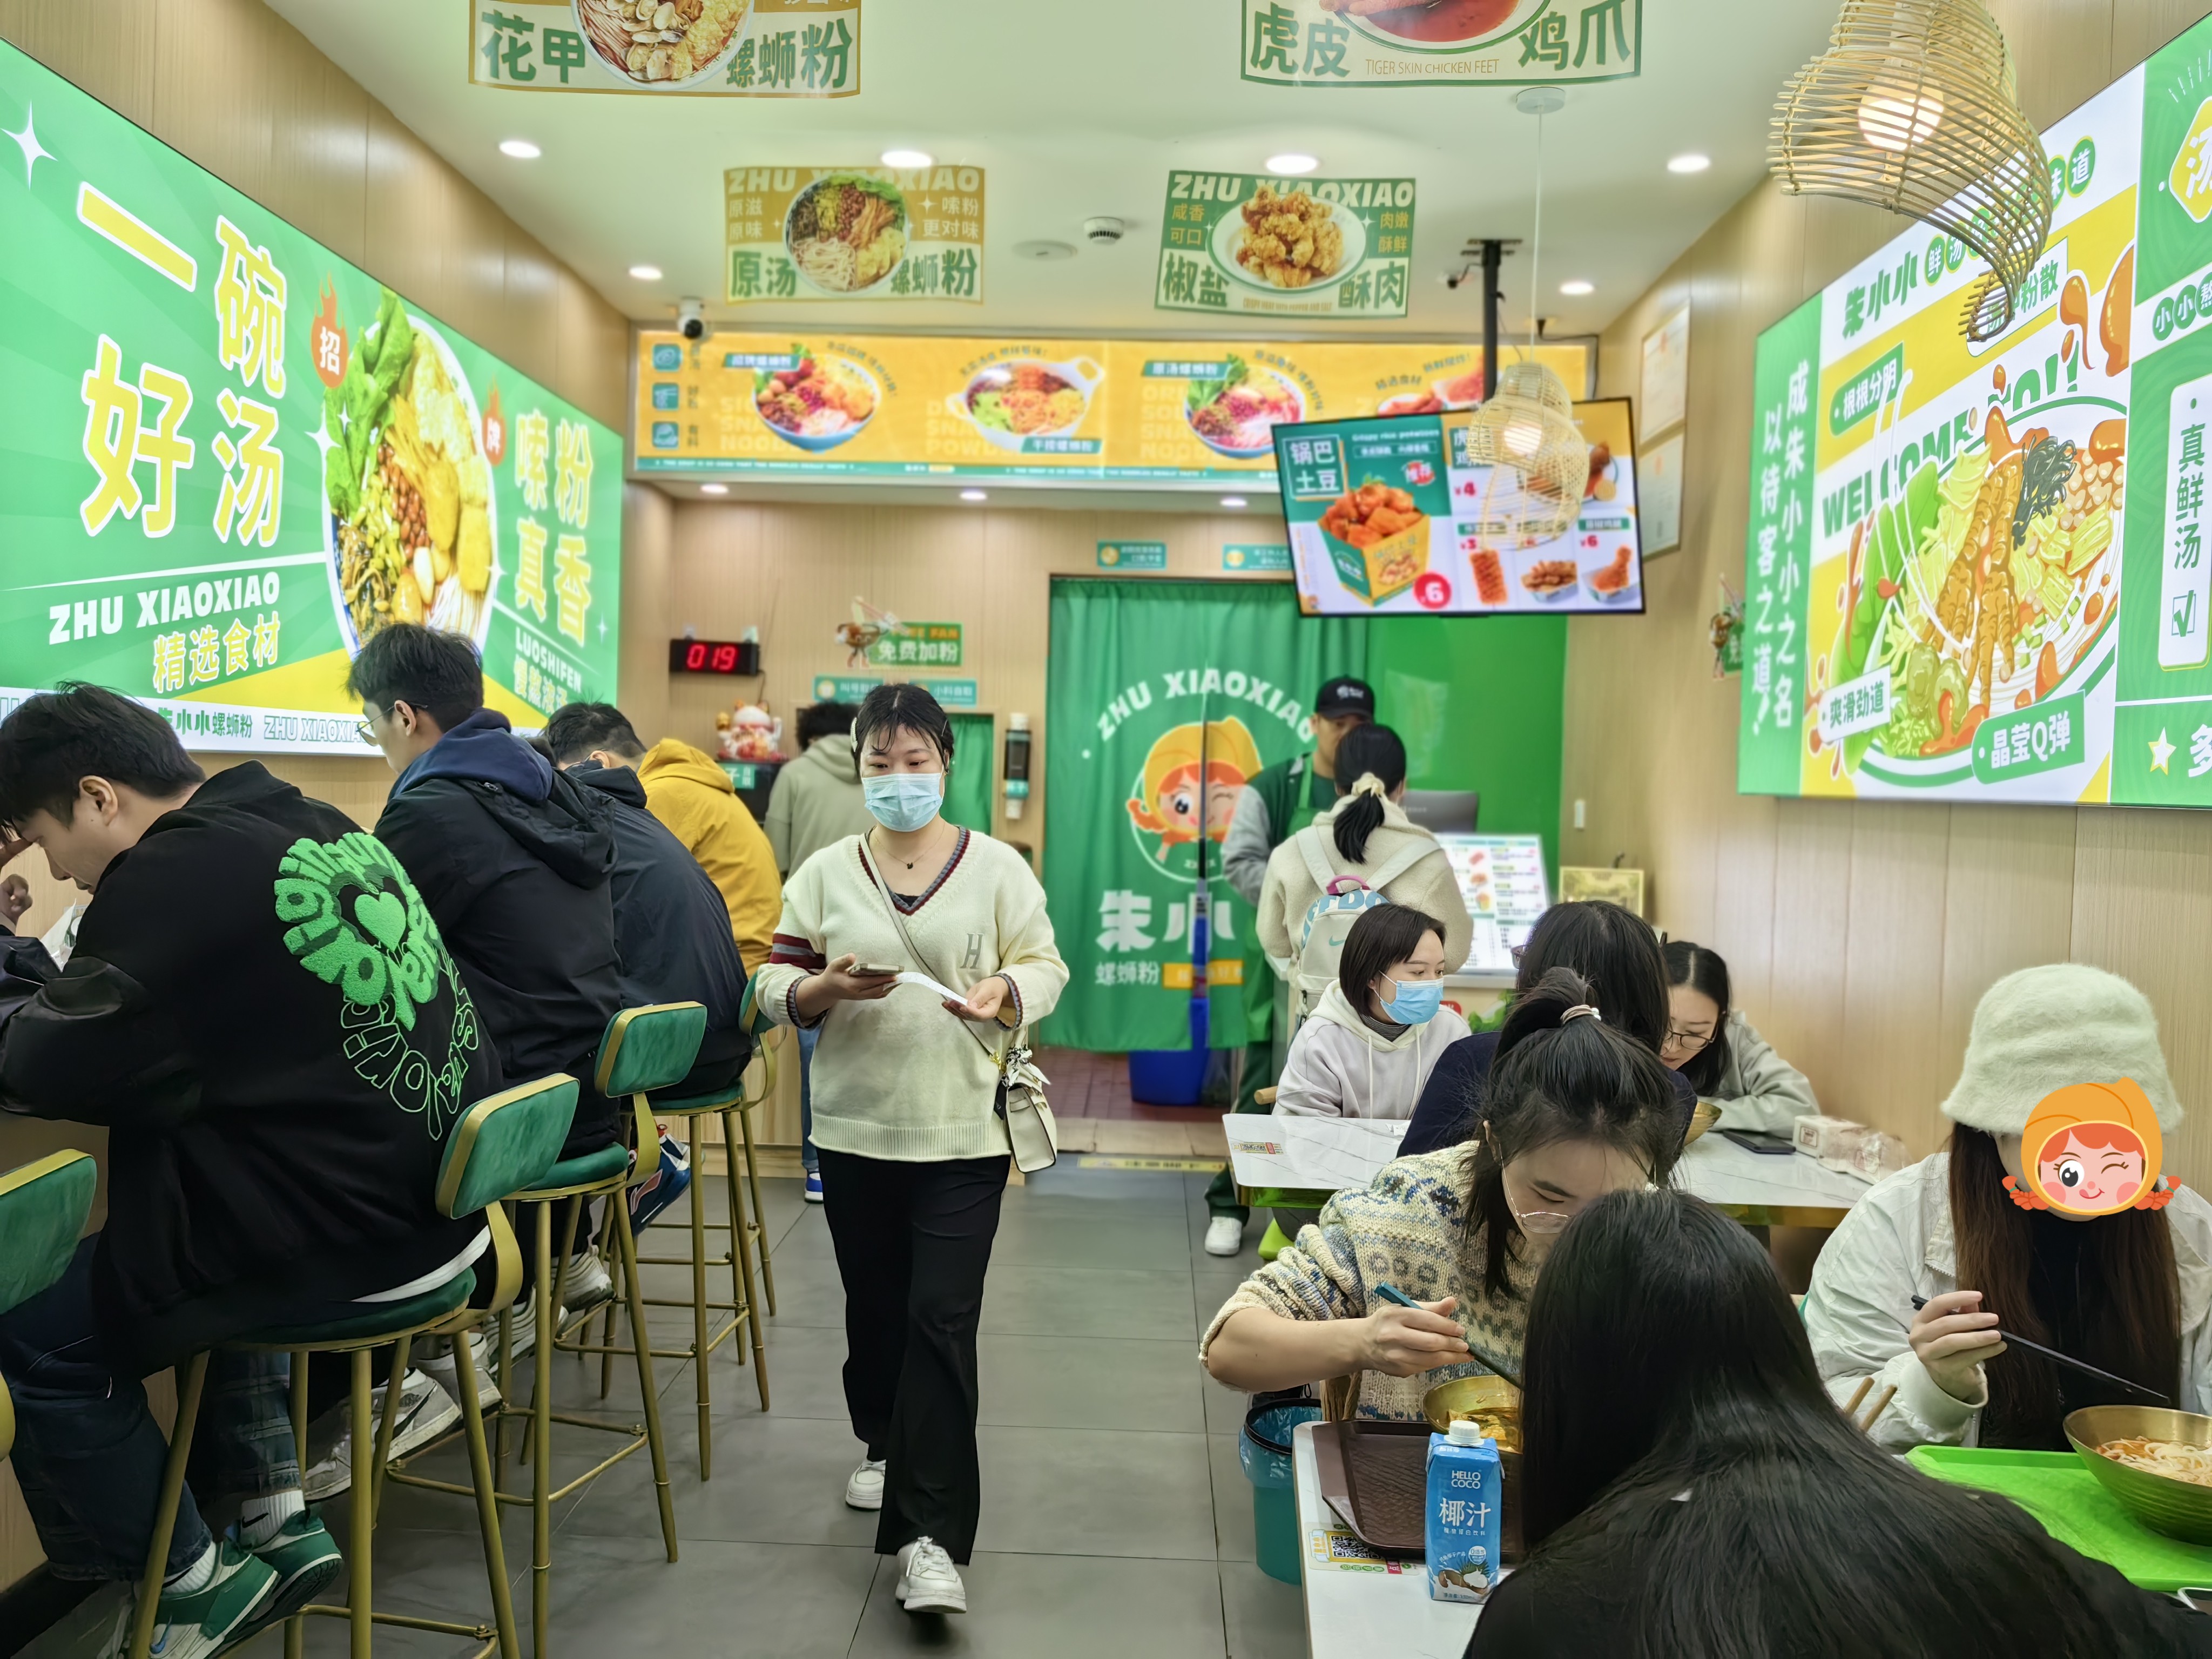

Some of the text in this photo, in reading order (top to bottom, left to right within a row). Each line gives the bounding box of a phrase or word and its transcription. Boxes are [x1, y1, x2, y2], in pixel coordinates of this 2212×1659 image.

[481, 10, 853, 89] 花甲 螺蛳粉
[1250, 0, 1630, 79] 虎皮 鸡爪
[1365, 58, 1499, 76] TIGER SKIN CHICKEN FEET
[728, 169, 797, 194] ZHU
[1171, 174, 1242, 202] ZHU
[729, 197, 763, 217] 原滋
[942, 196, 979, 217] 嗦粉
[1172, 204, 1205, 222] 咸香
[1380, 211, 1409, 230] 肉嫩
[729, 221, 763, 241] 原味
[922, 219, 980, 240] 更对味
[1170, 227, 1202, 246] 可口
[1378, 235, 1408, 254] 酥鲜
[77, 181, 287, 399] 一碗
[731, 248, 977, 298] 原汤 螺蛳粉
[1164, 252, 1405, 310] 椒盐 酥肉
[1842, 251, 1918, 340] 朱小小
[319, 326, 340, 375] 招
[1842, 357, 1897, 422] 根根分明
[80, 333, 284, 548] 好汤
[487, 417, 501, 455] 牌
[1290, 440, 1337, 465] 锅巴
[515, 408, 594, 530] 嗦粉
[1295, 469, 1340, 494] 土豆
[2174, 423, 2206, 570] 真鲜汤
[1773, 359, 1809, 728] 成朱小小之名
[514, 516, 592, 647] 真香
[1752, 403, 1783, 736] 以待客之道!
[49, 571, 280, 645] ZHU XIAOXIAO
[152, 610, 281, 693] 精选食材
[515, 625, 582, 694] LUOSHIFEN
[686, 643, 737, 672] 019
[877, 640, 958, 662] 免费加粉
[1097, 668, 1316, 744] ZHU XIAOXIAO
[1829, 680, 1885, 731] 爽滑劲道
[264, 716, 298, 741] ZHU
[1991, 710, 2072, 770] 晶莹Q弹
[960, 933, 984, 970] H
[1094, 960, 1161, 987] 螺蛳粉
[1451, 1470, 1481, 1481] HELLO
[1451, 1480, 1481, 1489] COCO
[1439, 1497, 1491, 1528] 椰汁
